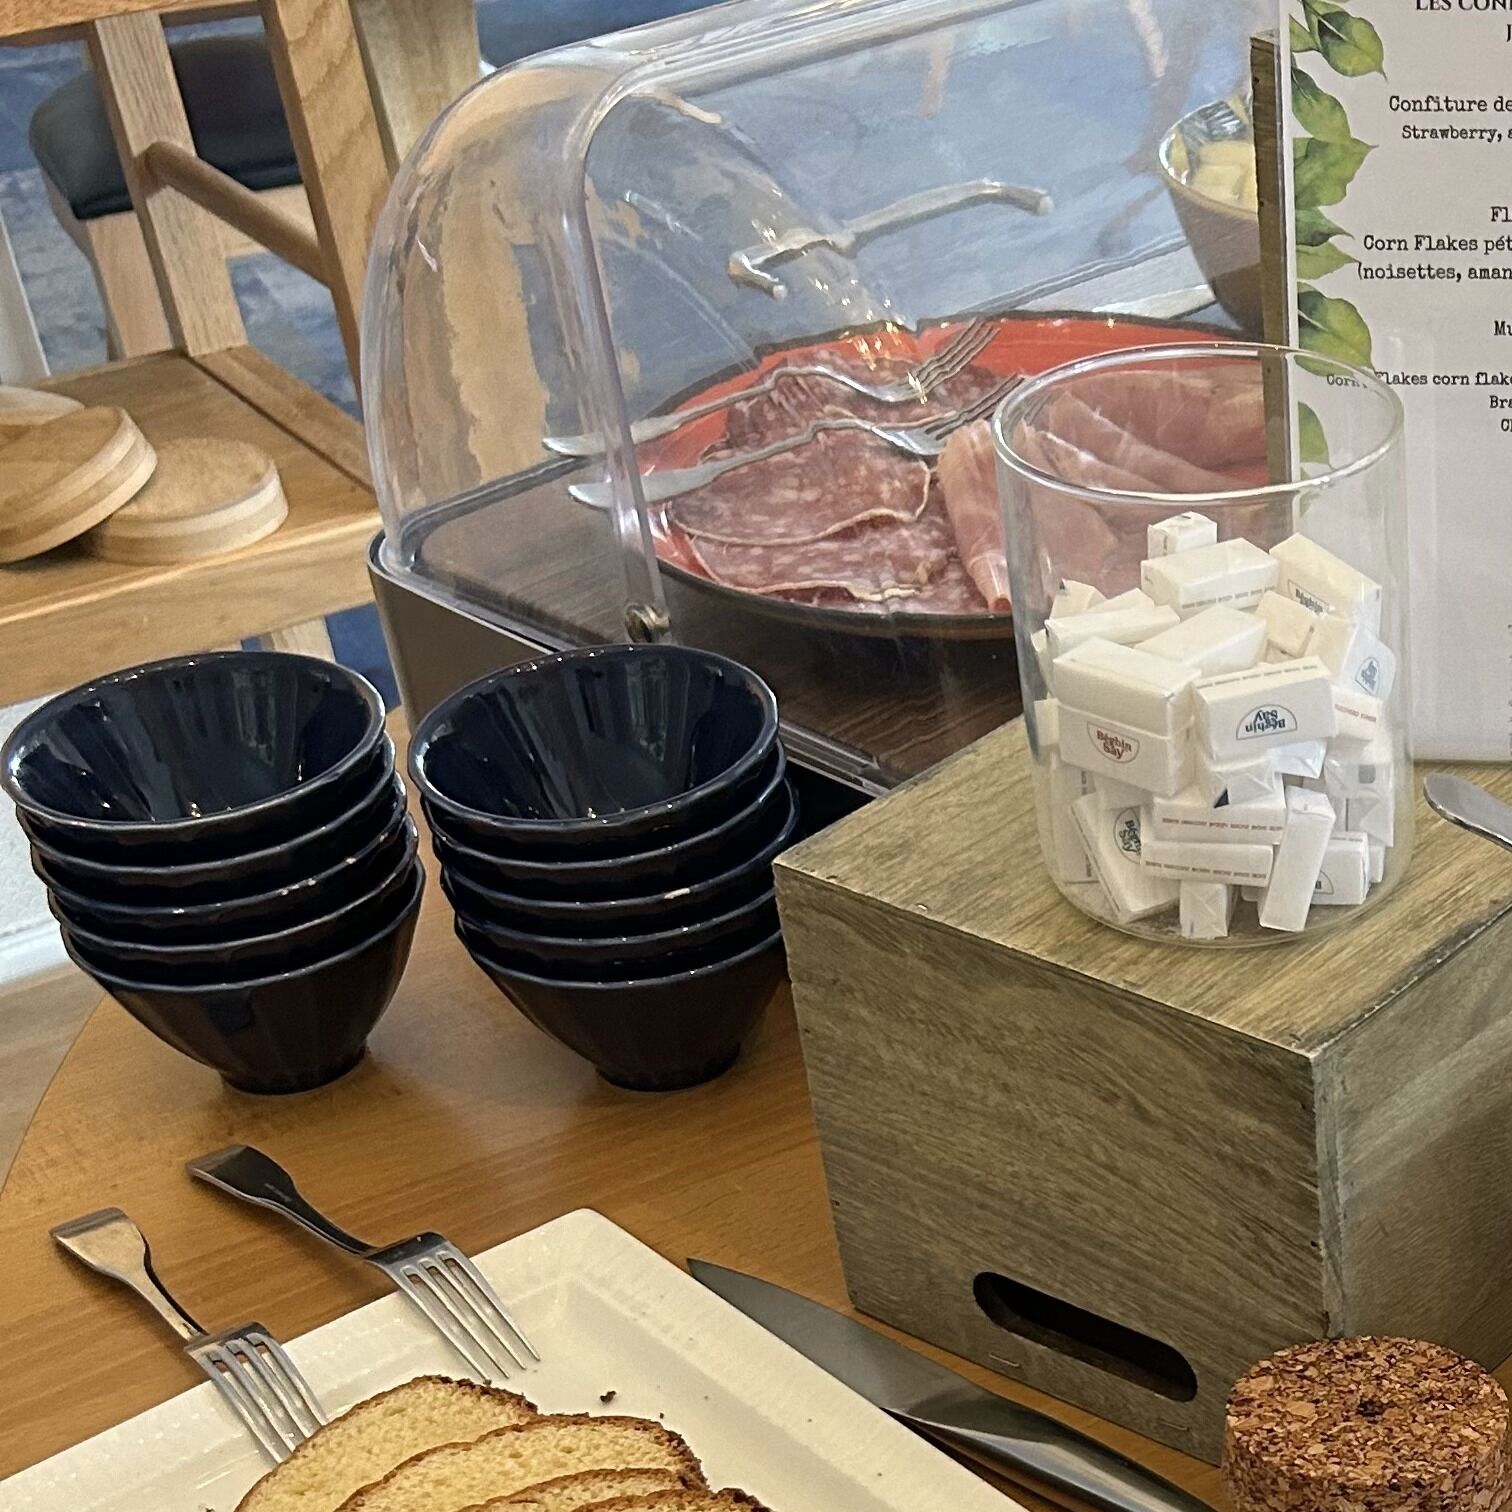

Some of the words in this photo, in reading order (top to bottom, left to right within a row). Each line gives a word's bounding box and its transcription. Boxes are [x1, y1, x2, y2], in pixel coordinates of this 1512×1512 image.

[1415, 0, 1452, 12] LES
[1388, 94, 1488, 113] Confiture
[1401, 124, 1503, 144] Strawberry,
[1363, 234, 1409, 252] Corn
[1413, 234, 1479, 252] Flakes
[1357, 262, 1462, 284] (noisettes,
[1432, 374, 1471, 386] corn
[1253, 708, 1279, 724] Say
[1096, 729, 1132, 753] Béghin
[1102, 741, 1125, 760] Say
